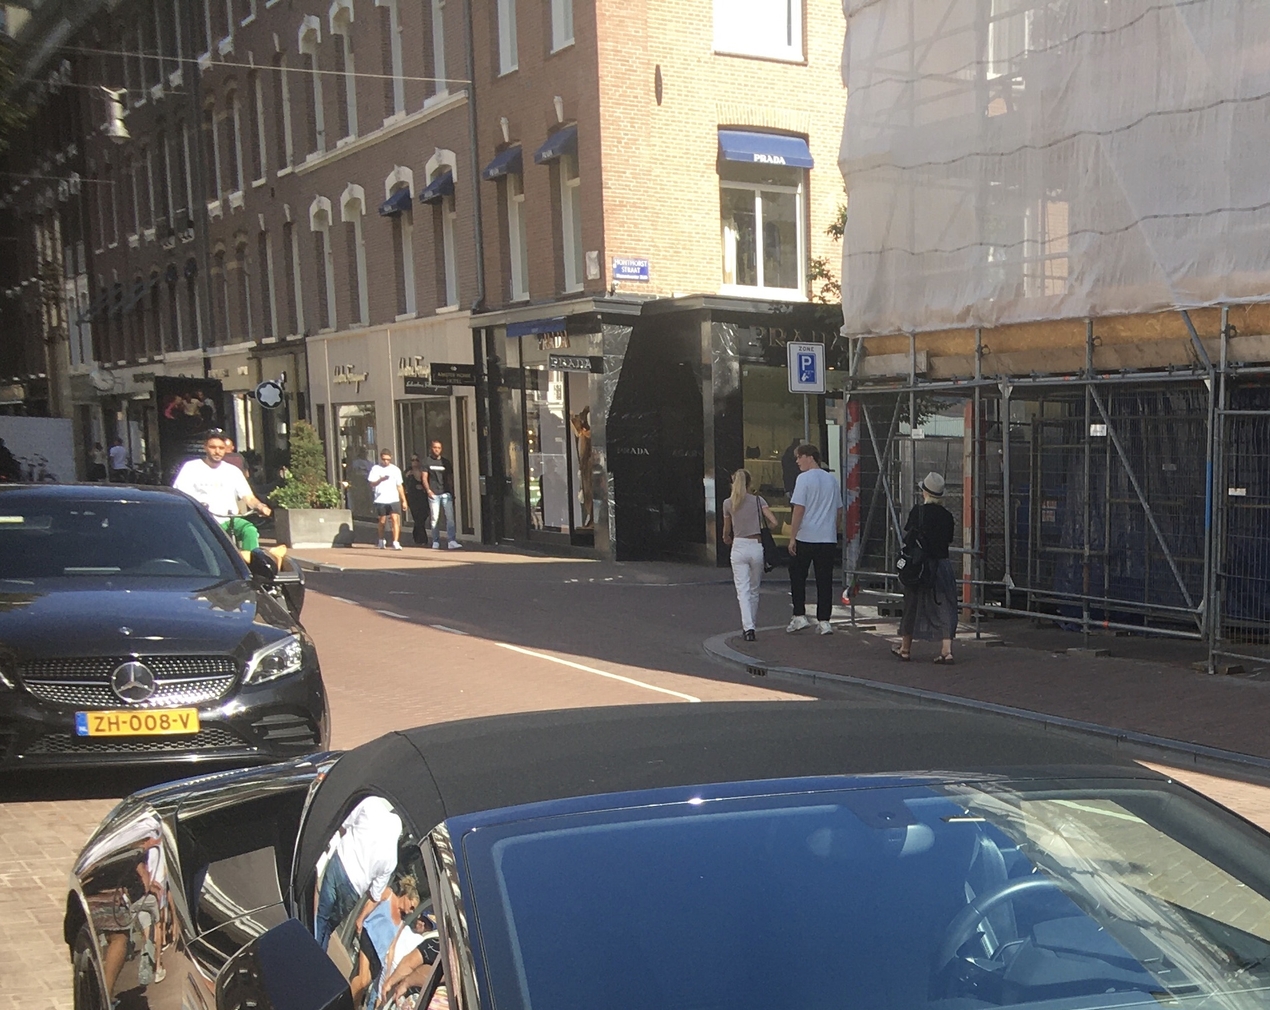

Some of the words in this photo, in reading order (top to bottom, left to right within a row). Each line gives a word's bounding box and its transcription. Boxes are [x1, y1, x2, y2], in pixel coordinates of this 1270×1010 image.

[753, 153, 786, 165] PRADA
[550, 356, 592, 369] PRADA
[801, 355, 812, 371] P
[93, 713, 190, 733] ZH-008-V
